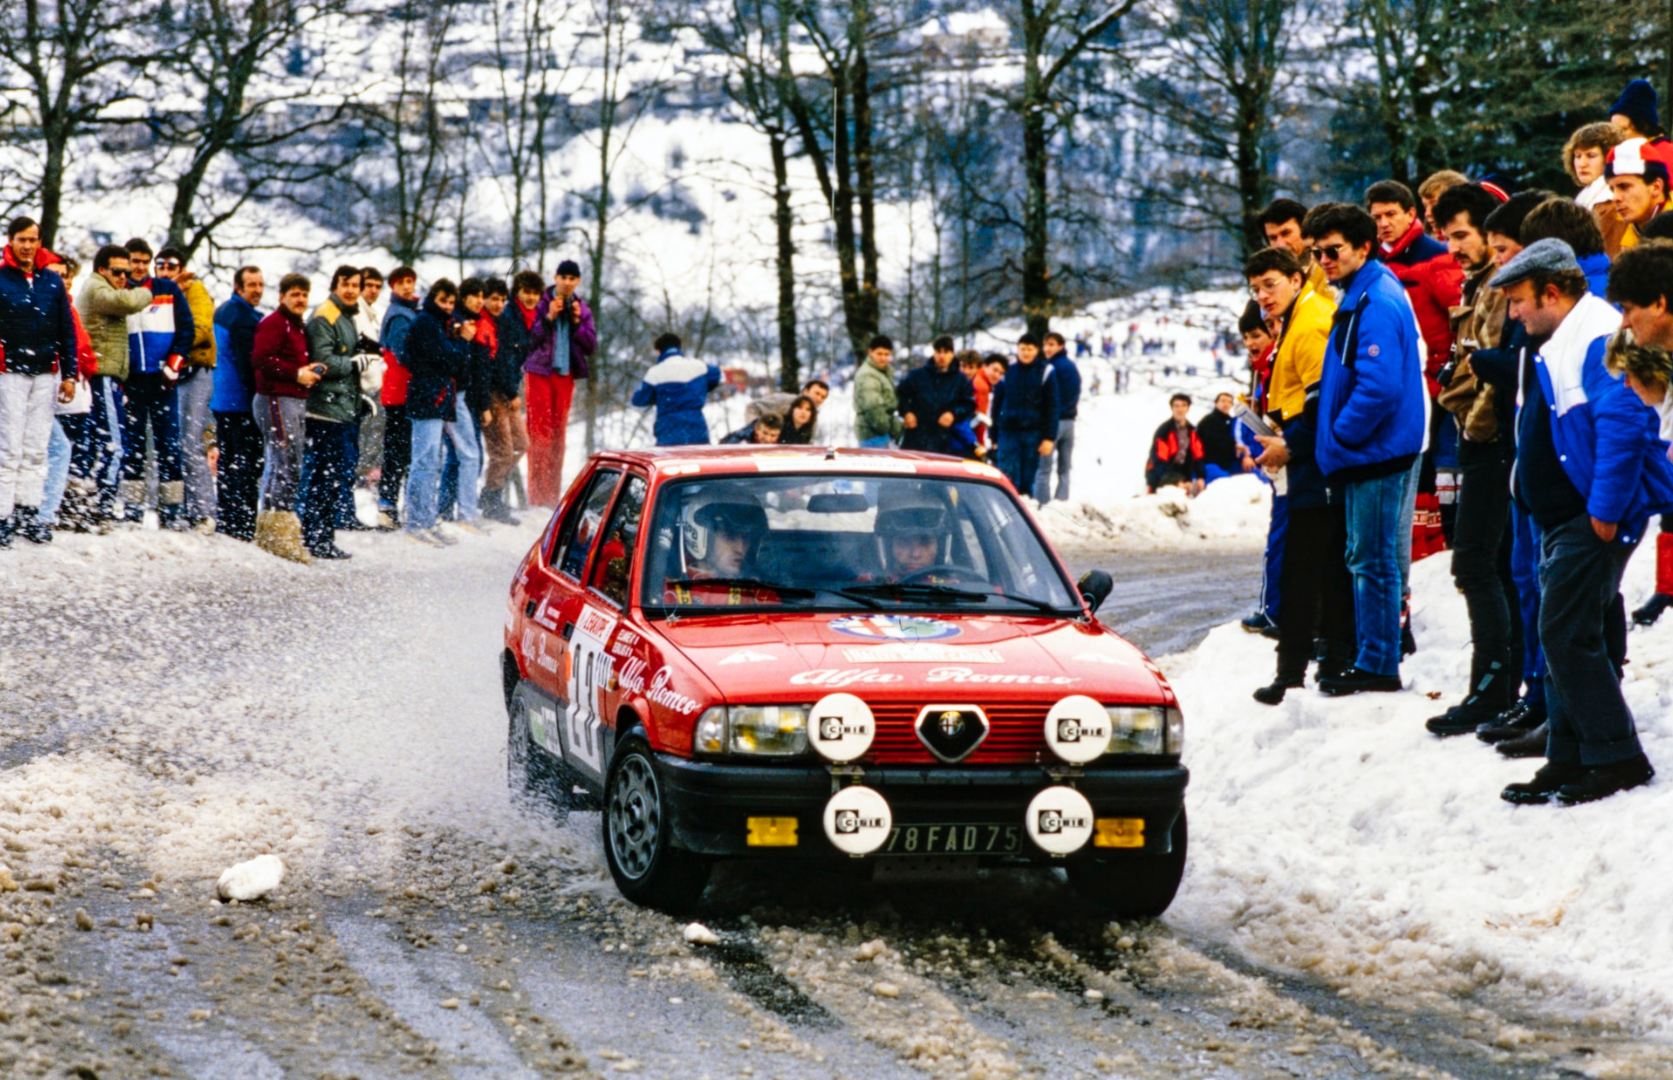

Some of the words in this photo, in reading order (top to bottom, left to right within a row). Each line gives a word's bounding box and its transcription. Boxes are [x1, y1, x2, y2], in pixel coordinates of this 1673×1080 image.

[618, 656, 648, 698] Alfa
[646, 665, 702, 715] Romeo
[790, 667, 904, 689] Alfa
[925, 666, 1082, 686] Romeo
[927, 826, 978, 852] FAD
[986, 826, 1018, 851] 75
